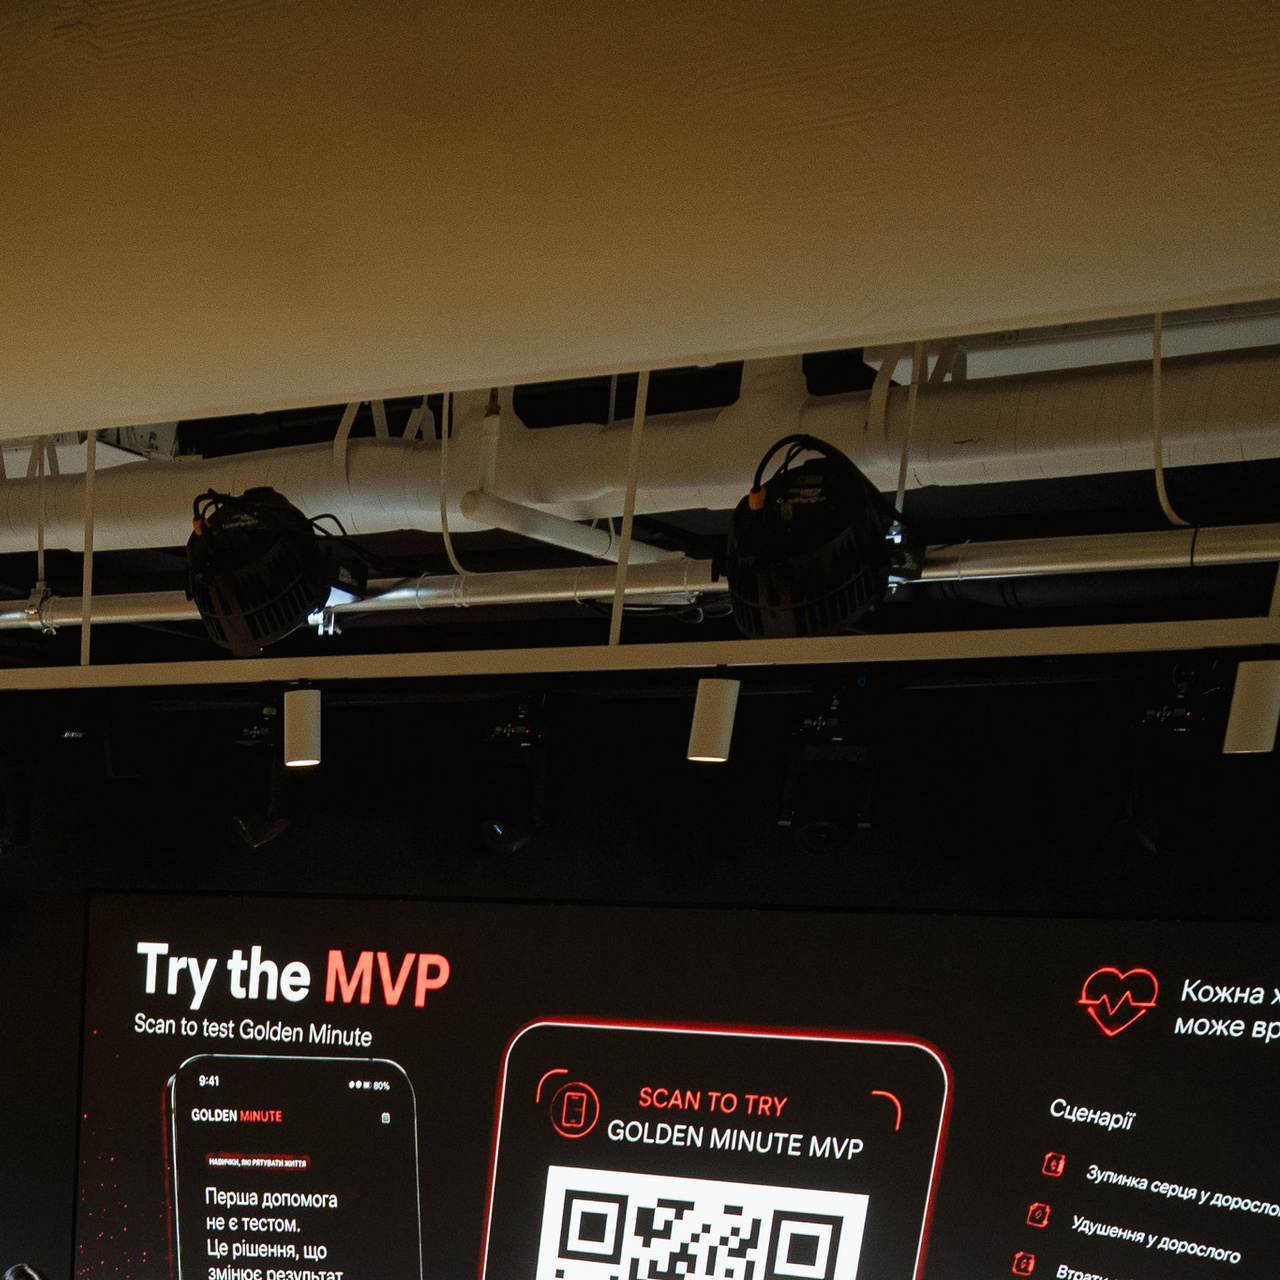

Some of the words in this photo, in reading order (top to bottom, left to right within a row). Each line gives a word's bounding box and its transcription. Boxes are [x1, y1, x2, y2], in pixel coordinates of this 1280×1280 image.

[137, 942, 217, 1010] Try
[227, 946, 310, 1002] the
[325, 950, 450, 1007] MVP
[1182, 979, 1264, 1004] Кожна
[135, 1013, 175, 1034] Scan
[181, 1018, 197, 1035] to
[203, 1019, 235, 1038] test
[240, 1019, 303, 1042] Golden
[309, 1023, 372, 1047] Minute
[1175, 1018, 1245, 1037] може
[199, 1075, 219, 1086] 9:41
[192, 1108, 237, 1121] GOLDEN
[240, 1110, 282, 1122] MINUTE
[639, 1087, 700, 1110] SCAN
[708, 1092, 737, 1113] TO
[745, 1095, 787, 1116] TRY
[1051, 1099, 1136, 1131] Сценарії
[608, 1120, 703, 1147] GOLDEN
[710, 1128, 803, 1156] MINUTE
[809, 1136, 863, 1159] MVP
[206, 1187, 258, 1208] Перша
[262, 1193, 337, 1208] допомога
[1087, 1165, 1148, 1189] Зупинка
[1151, 1181, 1197, 1200] серця
[1199, 1191, 1210, 1204] у
[1210, 1193, 1280, 1216] доросло
[207, 1217, 225, 1230] не
[229, 1217, 238, 1230] є
[242, 1218, 300, 1232] тестом.
[207, 1239, 228, 1259] Це
[233, 1239, 299, 1260] рішення,
[304, 1245, 327, 1261] що
[1072, 1215, 1145, 1242] Удушення
[1146, 1234, 1158, 1248] у
[1157, 1237, 1241, 1263] дорослого
